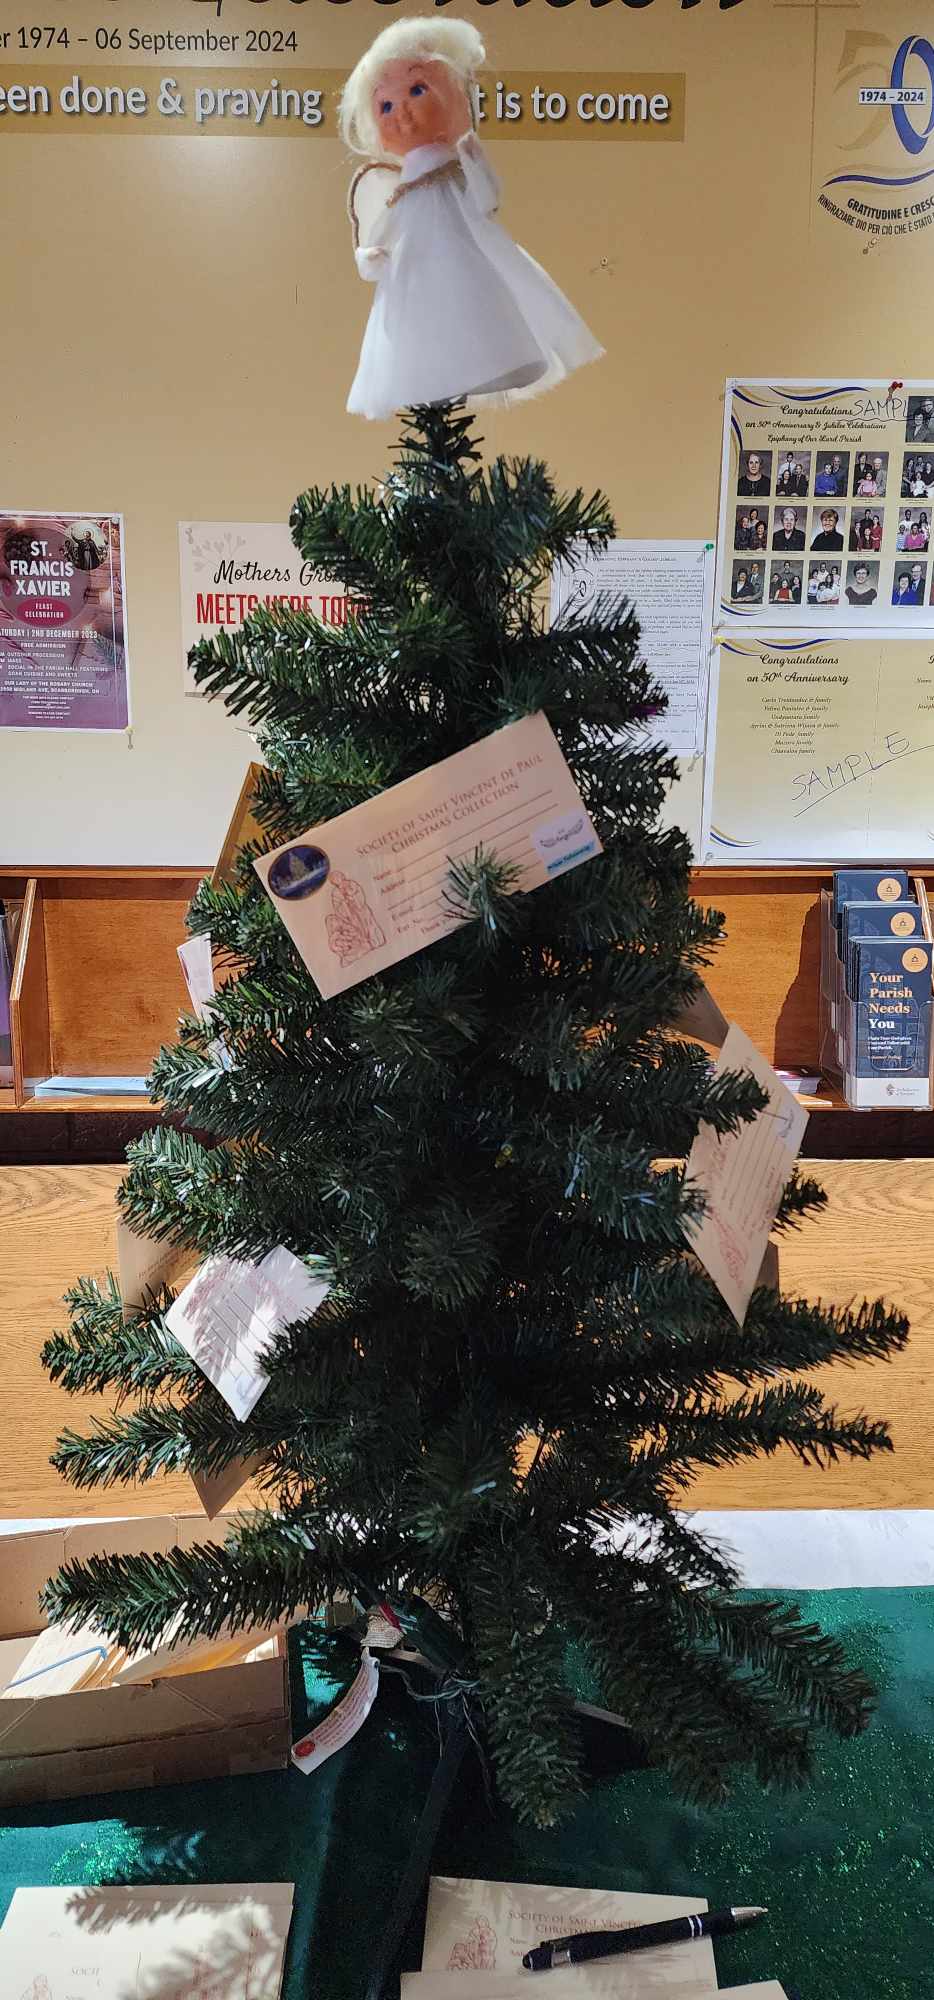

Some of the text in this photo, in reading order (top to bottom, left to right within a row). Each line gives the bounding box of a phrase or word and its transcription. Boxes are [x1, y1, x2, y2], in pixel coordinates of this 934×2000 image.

[0, 31, 11, 48] r
[18, 27, 70, 49] 1974
[95, 28, 121, 49] 06
[128, 28, 240, 53] September
[245, 30, 298, 52] 2024
[59, 76, 146, 114] done
[158, 78, 185, 115] &
[195, 79, 322, 125] praying
[496, 82, 521, 119] is
[531, 86, 567, 119] to
[577, 93, 669, 120] come
[860, 91, 887, 102] 1974
[897, 91, 924, 102] 2024
[818, 193, 856, 226] RINGRAZIARE
[867, 223, 880, 235] PER
[894, 223, 907, 235] CHE
[914, 216, 932, 230] STATO
[847, 198, 902, 220] GRATITUDINE
[903, 208, 909, 217] E
[780, 404, 853, 418] Congratulations
[772, 420, 814, 431] Anniversary
[846, 421, 886, 430] Celebrations
[839, 435, 862, 443] Parish
[30, 540, 52, 557] ST.
[10, 560, 75, 577] FRANCIS
[213, 560, 291, 585] Mothers
[15, 579, 71, 597] XAVIER
[35, 602, 53, 610] FEAST
[196, 592, 259, 625] MEETS
[24, 611, 64, 619] CELEBRATION
[46, 629, 80, 639] DECEMBER
[81, 630, 98, 639] 2023
[760, 654, 839, 668] Congratulations
[747, 675, 759, 683] on
[784, 671, 849, 686] Anniversary
[792, 732, 910, 800] SAMPLE
[357, 826, 402, 857] SOCIETY
[403, 818, 417, 834] OF
[418, 803, 452, 825] SAINT
[451, 776, 501, 807] VINCENT
[516, 752, 544, 773] PAUL
[392, 781, 521, 853] CHRISTMAS COLLECTION
[869, 973, 903, 983] Your
[870, 987, 912, 998] Parish
[869, 1002, 910, 1014] Needs
[868, 1018, 895, 1029] You
[508, 1911, 548, 1921] SOCIETY
